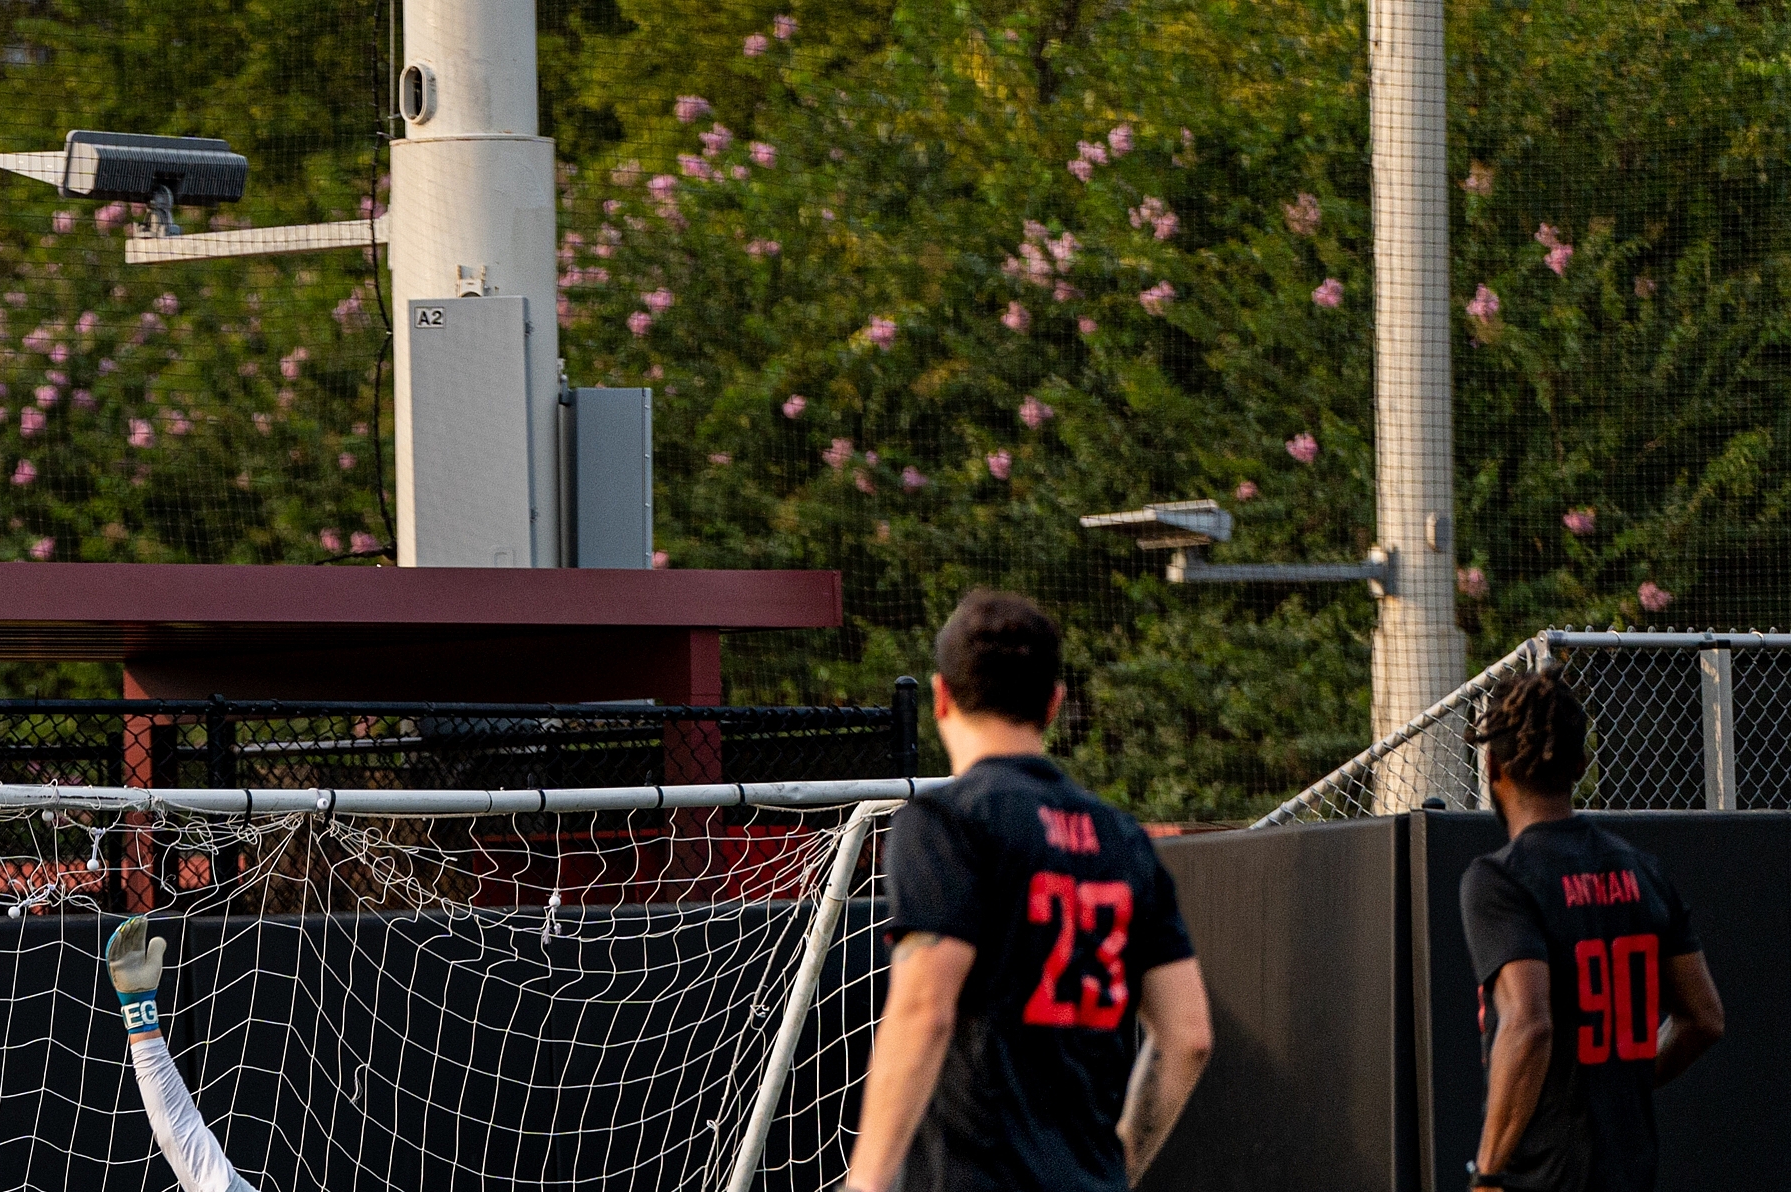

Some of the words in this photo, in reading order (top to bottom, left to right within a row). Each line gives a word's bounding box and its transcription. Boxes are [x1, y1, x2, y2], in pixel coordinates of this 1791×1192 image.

[417, 310, 442, 326] A2
[1023, 870, 1134, 1031] 23
[1574, 933, 1659, 1065] 90
